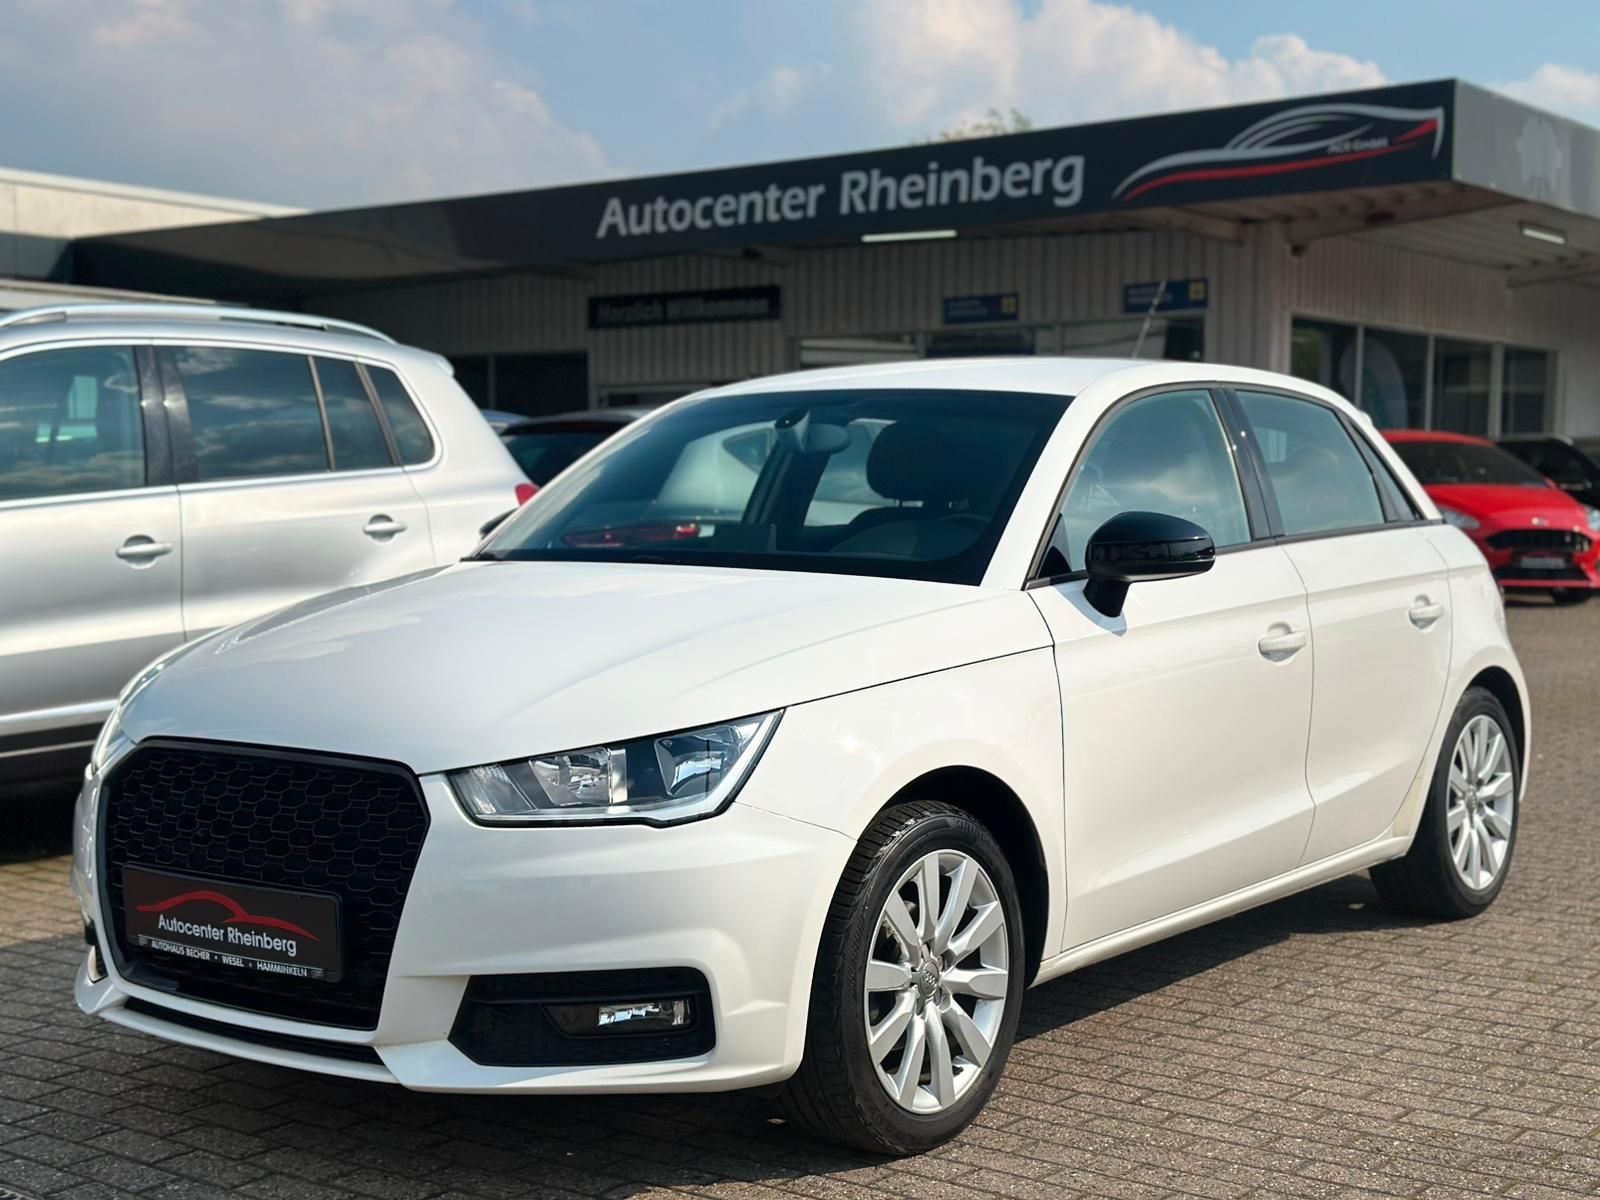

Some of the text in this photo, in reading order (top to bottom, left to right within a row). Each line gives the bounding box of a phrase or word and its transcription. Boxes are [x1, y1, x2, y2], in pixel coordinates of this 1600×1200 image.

[597, 155, 1085, 240] Autocenter Rheinberg
[157, 914, 297, 957] Autocenter Rheinberg
[151, 939, 308, 977] AUTOHAUS BECHER WESEL HAMMINKELN
